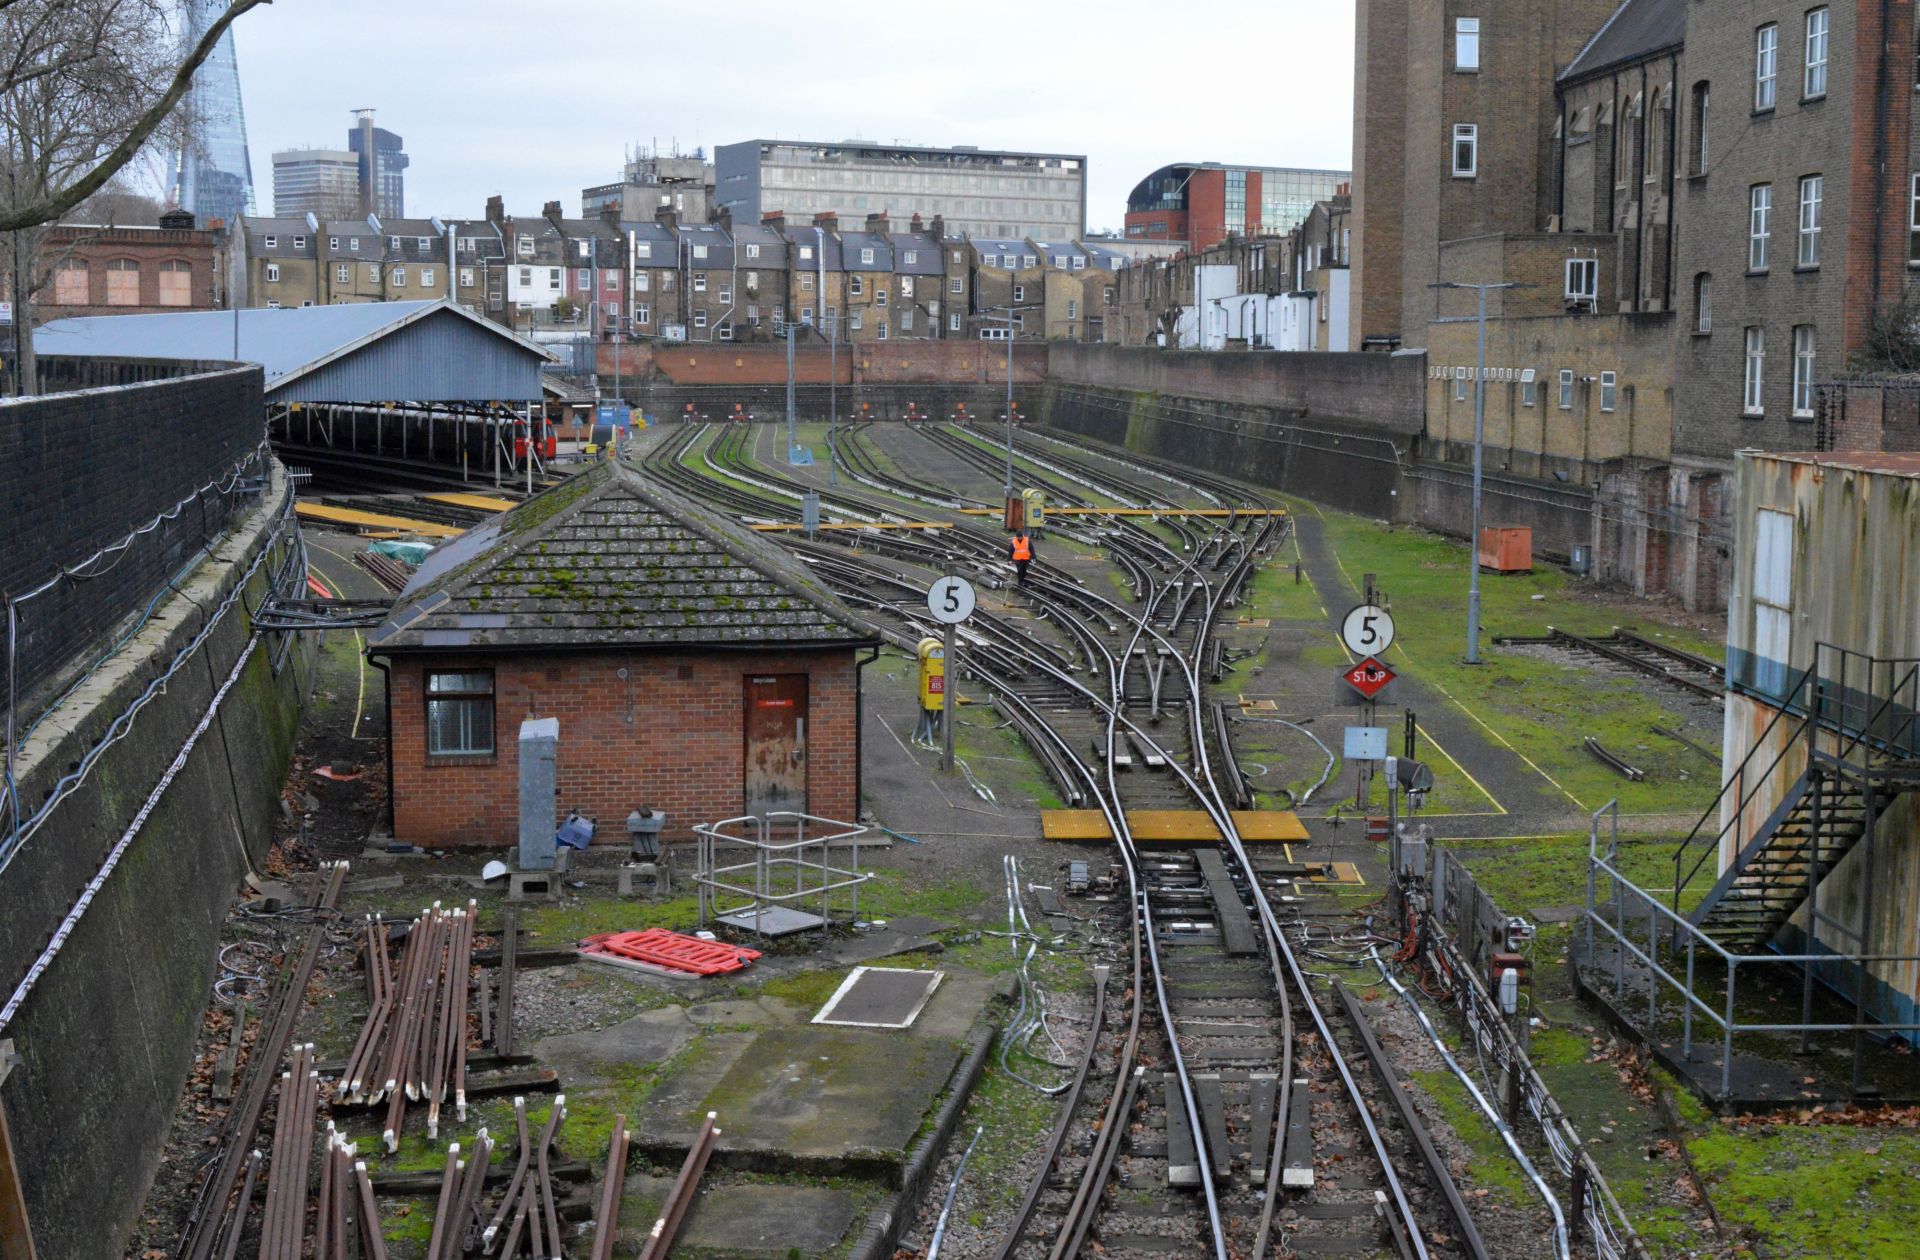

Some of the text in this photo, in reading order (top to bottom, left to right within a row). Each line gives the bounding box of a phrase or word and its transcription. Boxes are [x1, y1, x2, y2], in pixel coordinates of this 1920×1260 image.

[943, 585, 960, 613] 5
[1360, 616, 1378, 645] 5
[1353, 670, 1386, 683] STOP
